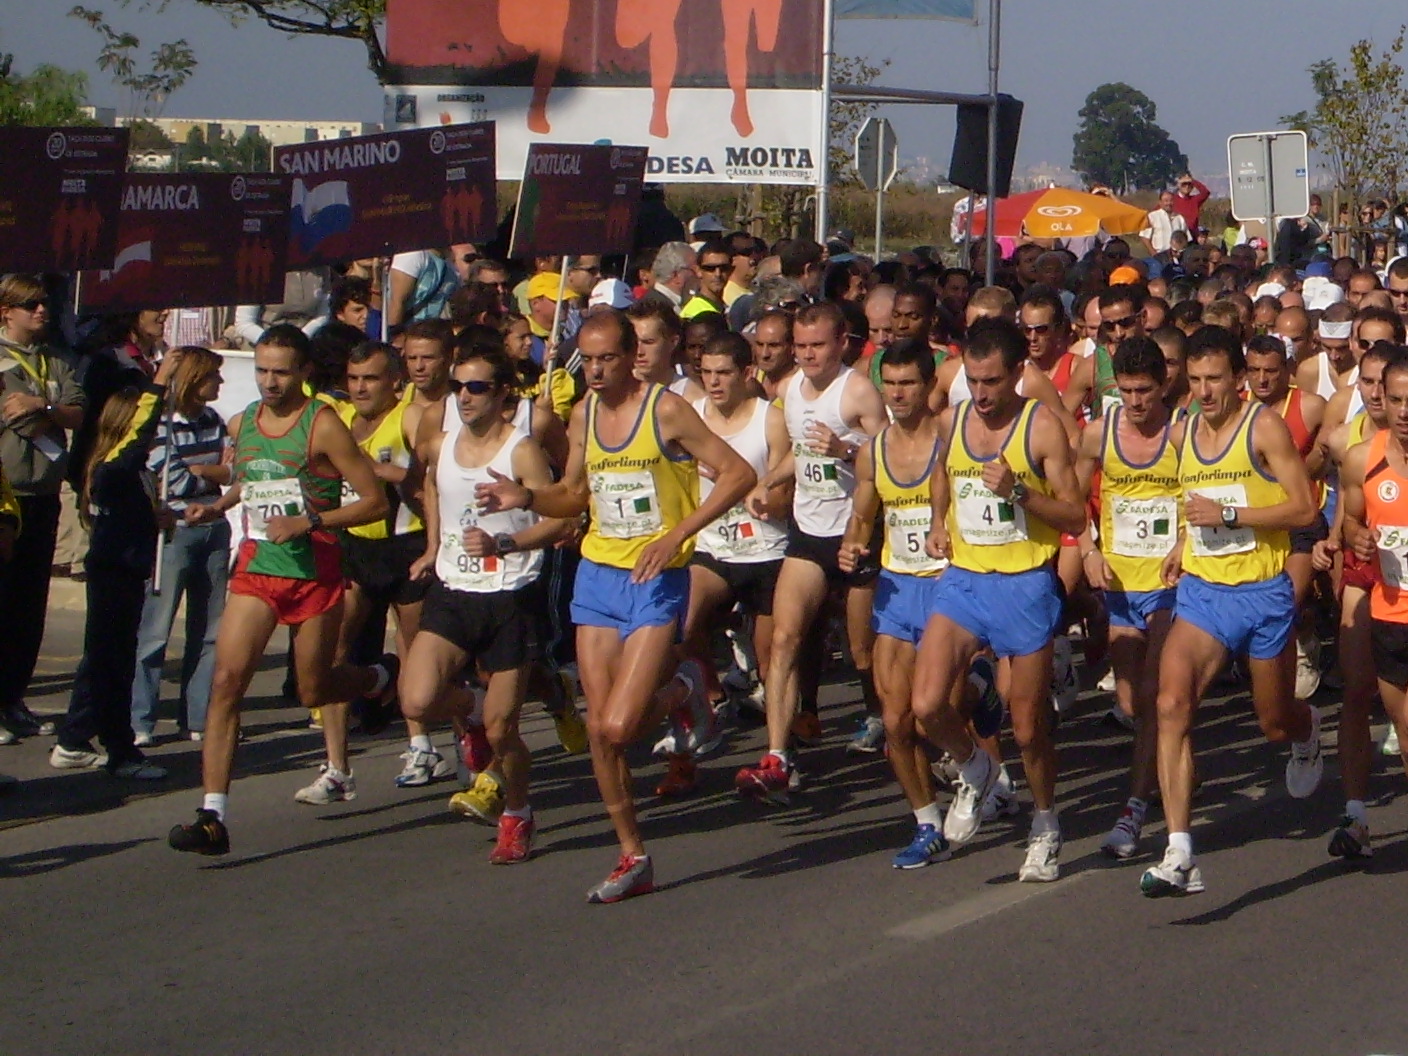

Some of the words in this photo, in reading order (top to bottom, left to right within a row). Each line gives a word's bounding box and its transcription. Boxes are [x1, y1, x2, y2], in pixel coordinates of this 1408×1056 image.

[280, 149, 319, 174] SAN
[323, 140, 401, 171] MARINO
[530, 153, 581, 175] PORTUGAL
[647, 156, 714, 174] DESA
[725, 147, 814, 168] MOITA
[120, 185, 199, 210] AMARCA
[1051, 222, 1073, 231] OLA
[804, 463, 822, 482] 46
[258, 504, 284, 520] 70
[614, 498, 624, 519] 1
[982, 504, 994, 526] 4
[718, 522, 739, 542] 97
[1136, 520, 1148, 539] 3
[907, 532, 920, 553] 5
[457, 554, 481, 574] 98
